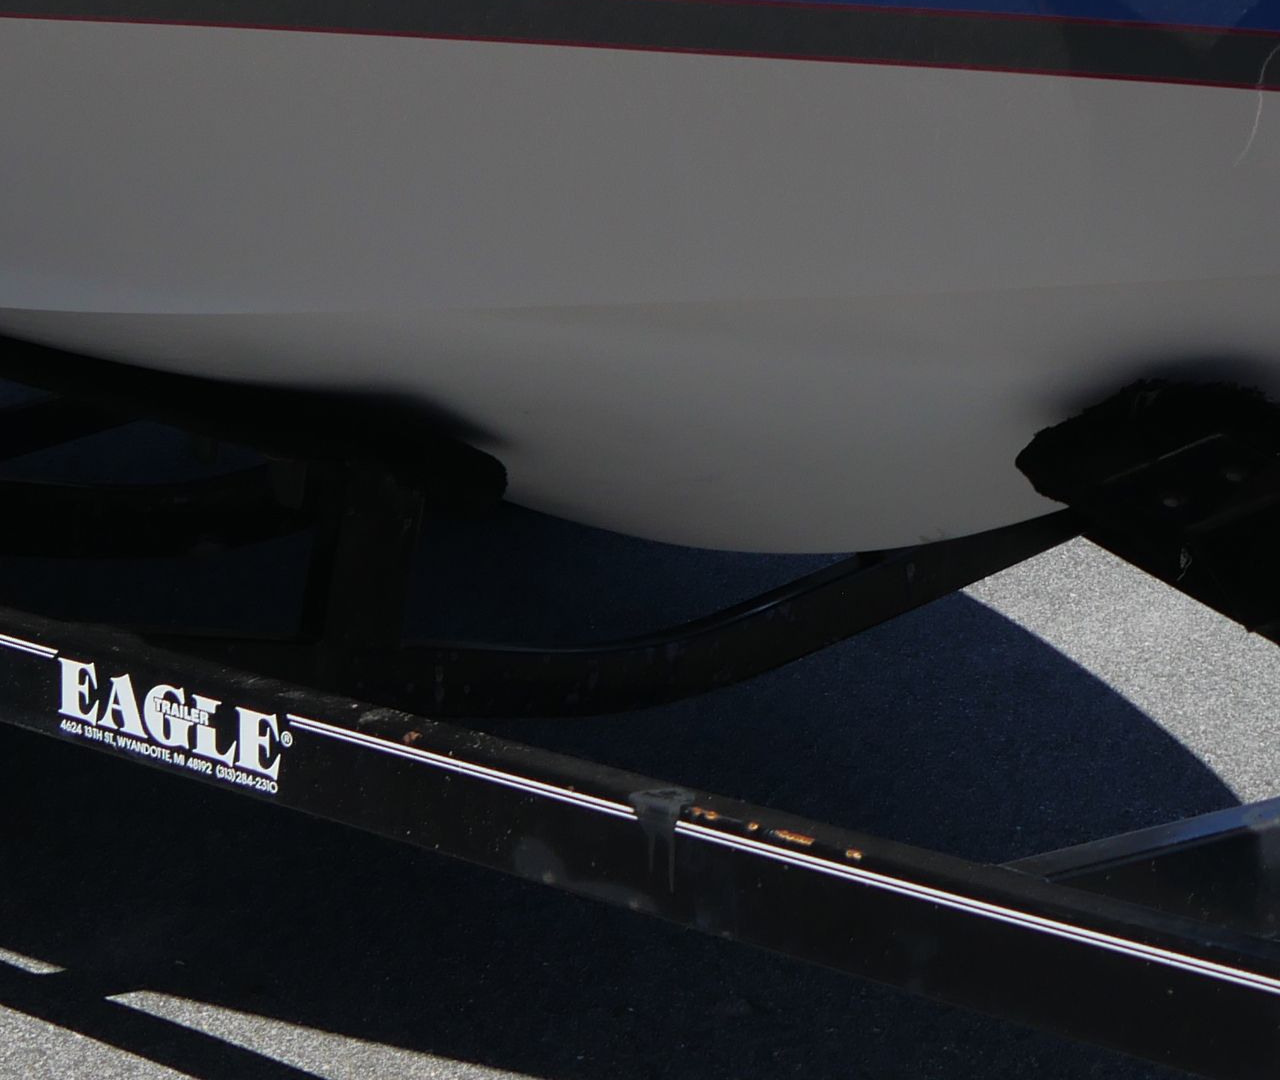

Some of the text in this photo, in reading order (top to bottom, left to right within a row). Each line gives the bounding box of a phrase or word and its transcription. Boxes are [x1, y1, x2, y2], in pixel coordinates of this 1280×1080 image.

[153, 696, 209, 726] TRAILER
[60, 719, 82, 735] 4624
[83, 725, 103, 741] 13TH
[173, 752, 185, 766] MI
[186, 757, 213, 774] 48192
